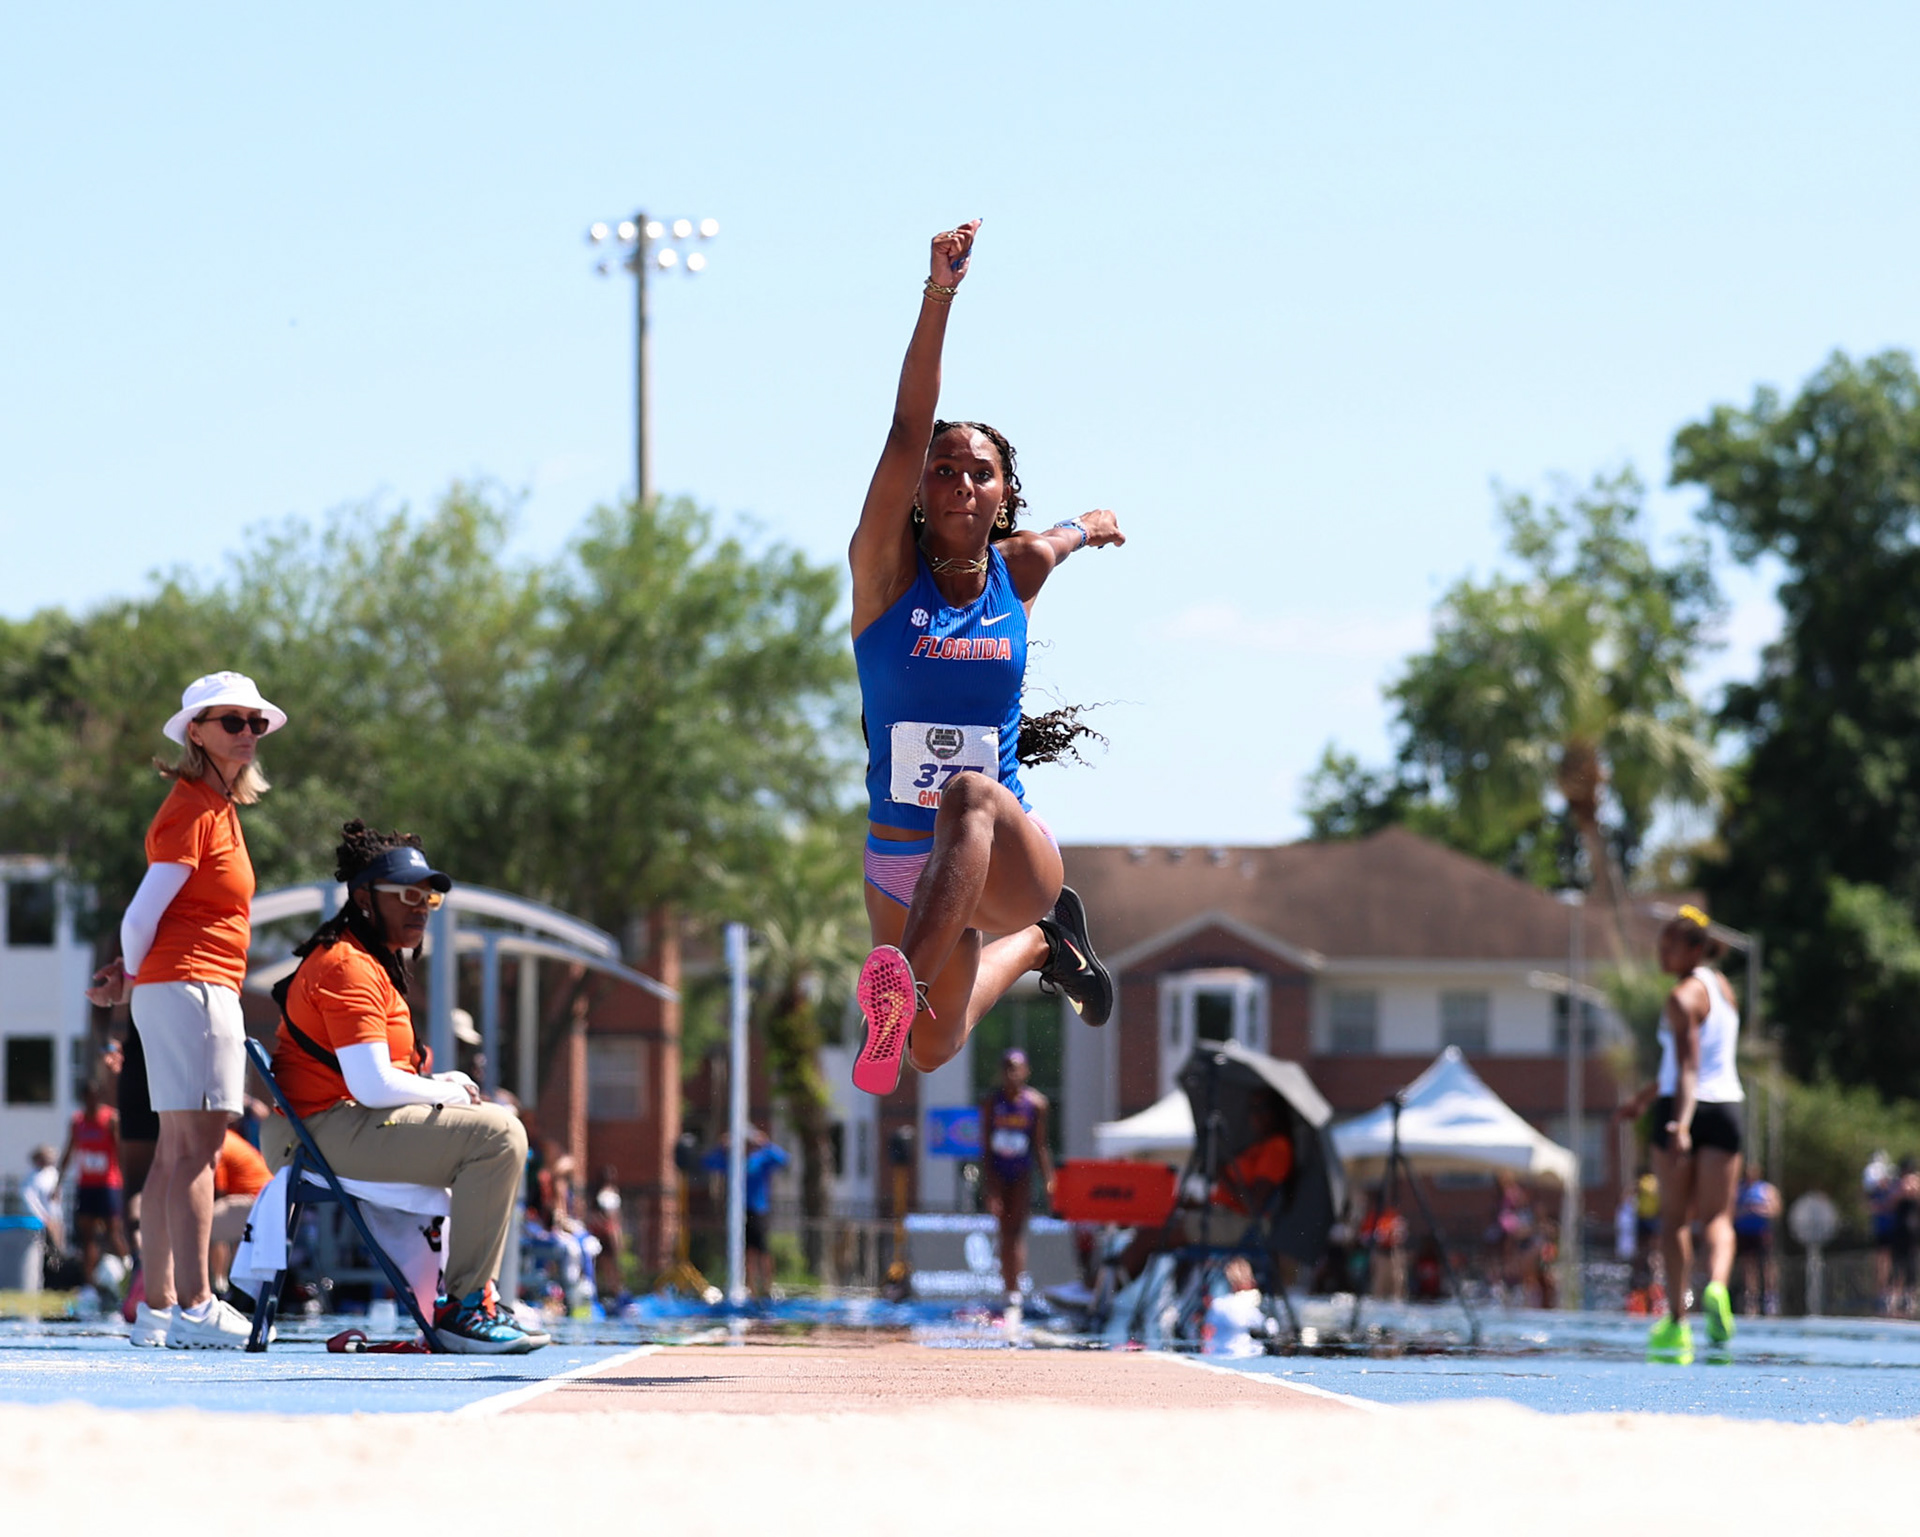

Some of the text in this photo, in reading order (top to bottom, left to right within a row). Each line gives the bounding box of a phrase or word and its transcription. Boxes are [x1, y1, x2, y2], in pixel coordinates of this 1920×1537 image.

[911, 608, 929, 627] SEC
[910, 635, 1012, 660] FLORIDA
[913, 763, 984, 790] 37
